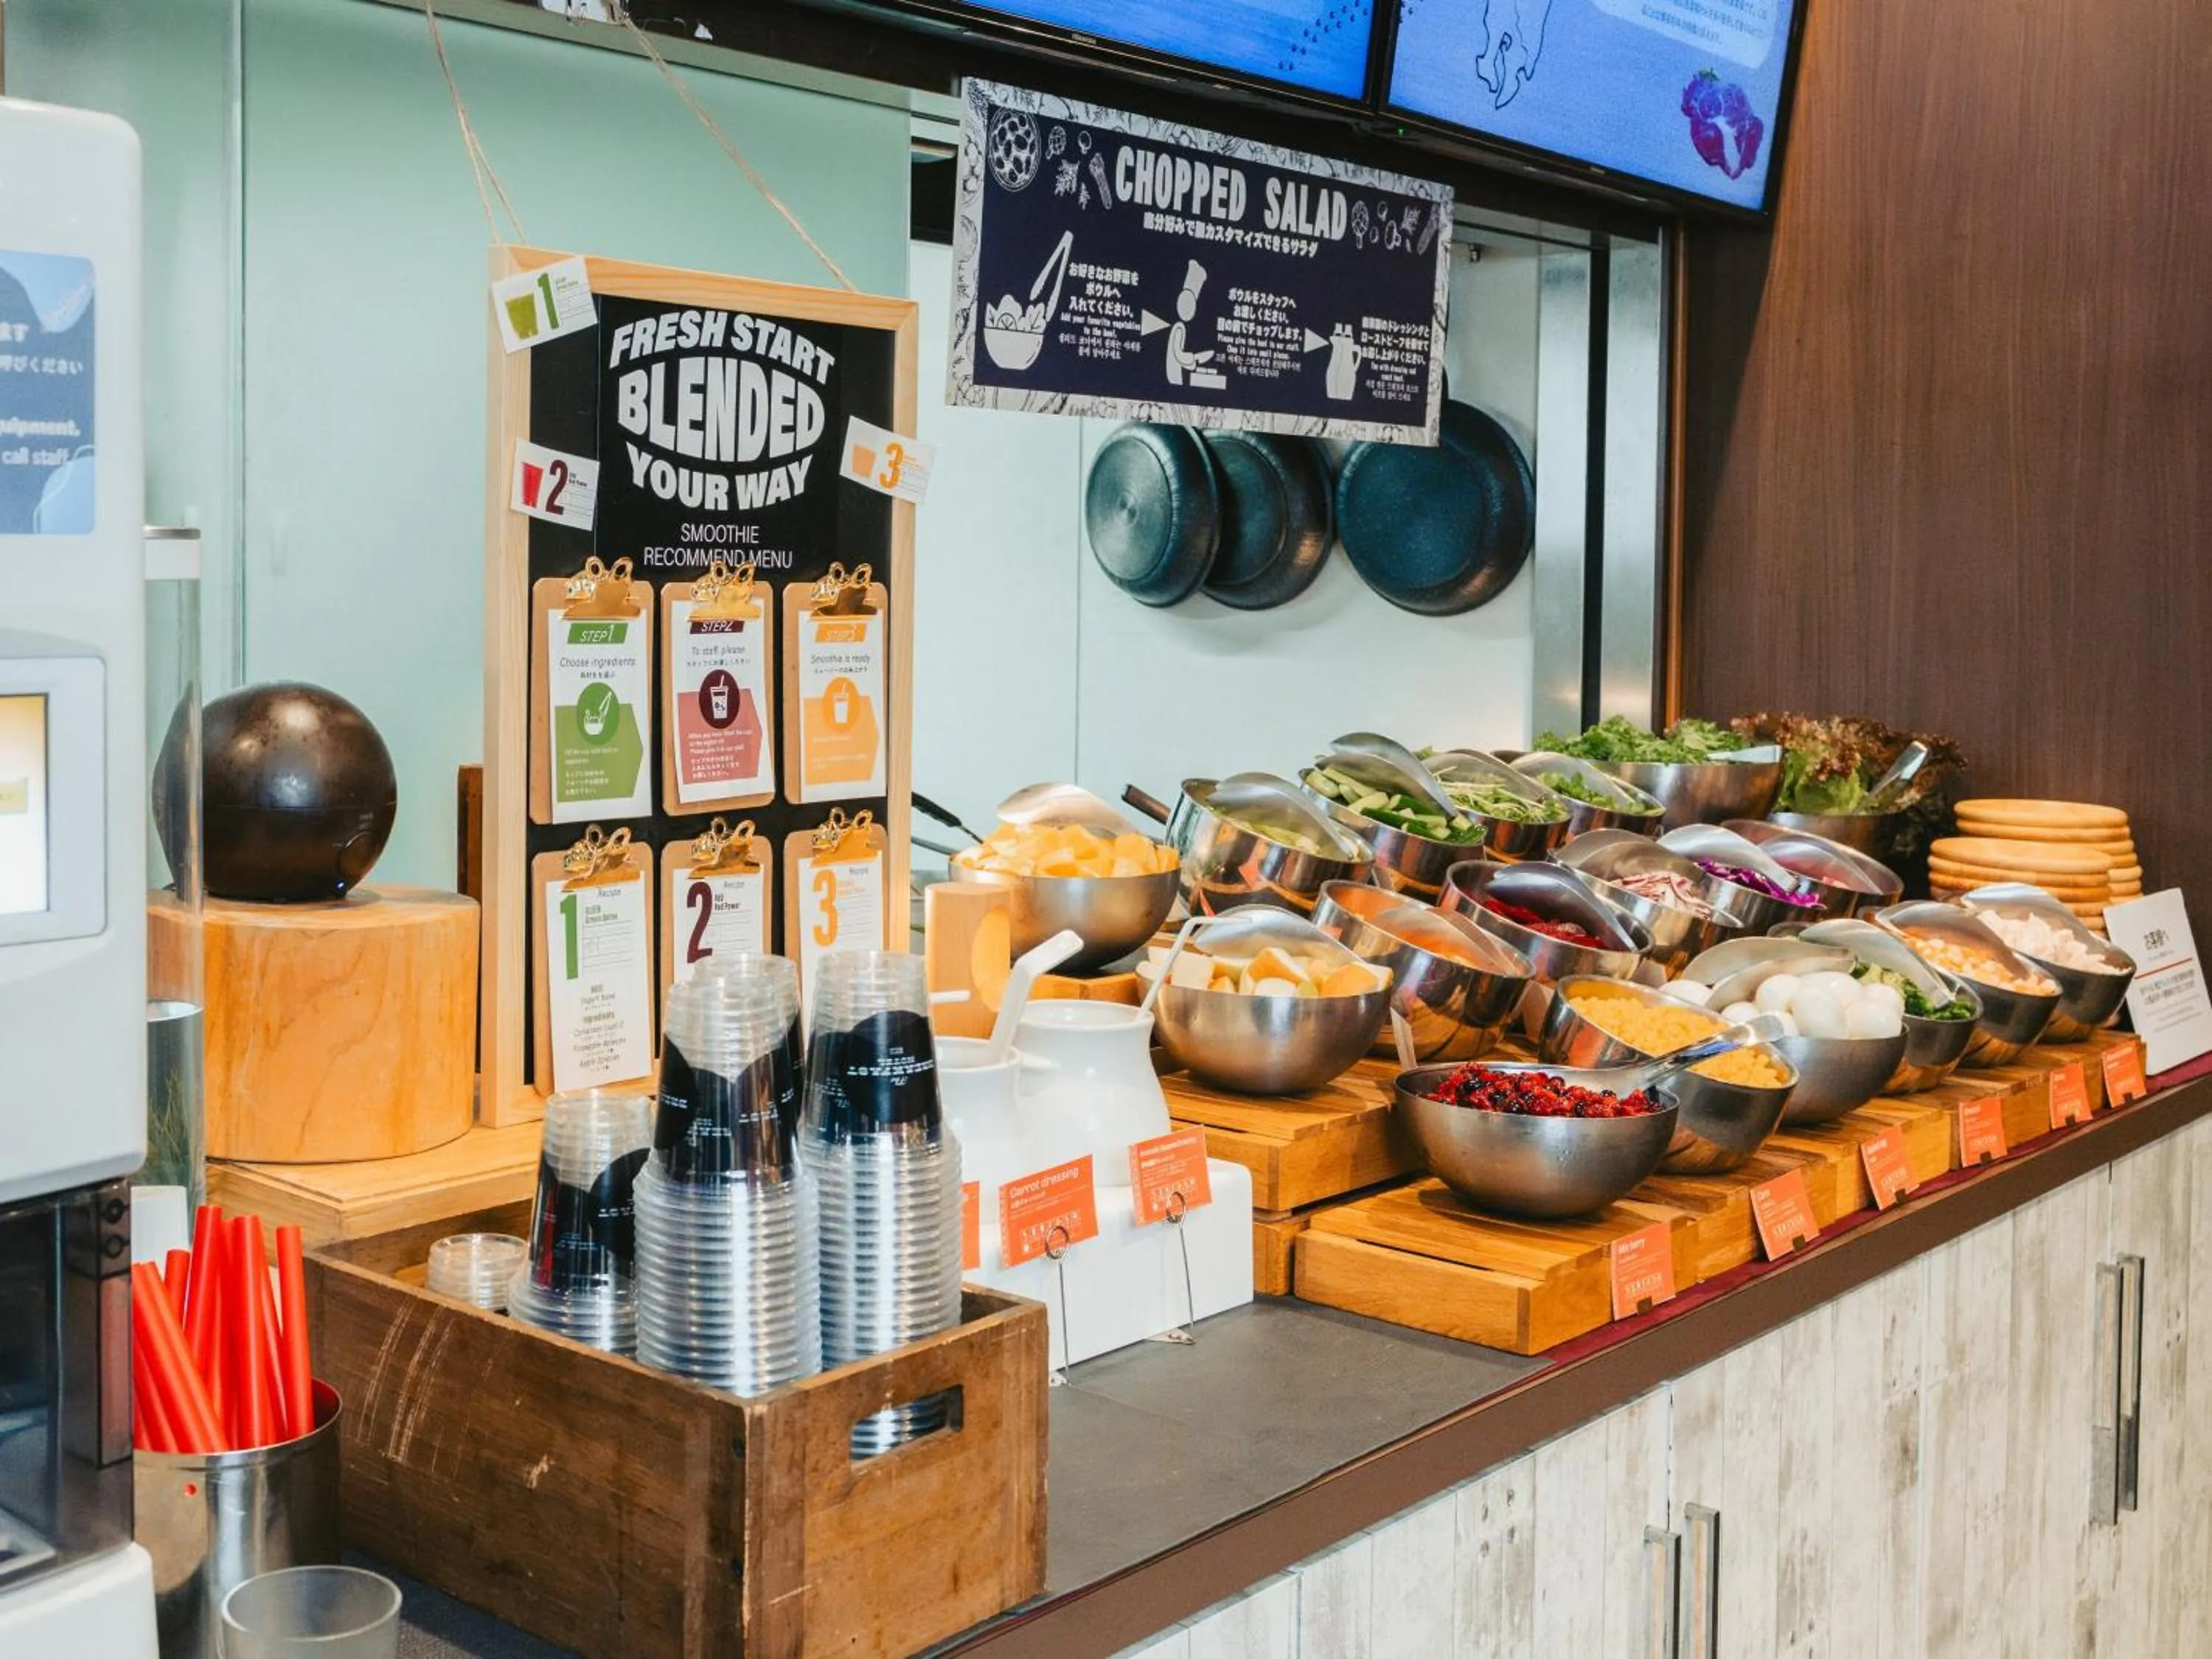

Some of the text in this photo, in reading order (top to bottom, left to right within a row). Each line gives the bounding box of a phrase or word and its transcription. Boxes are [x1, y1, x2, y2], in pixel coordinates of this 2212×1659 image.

[1116, 146, 1347, 240] CHOPPED SALAD
[537, 272, 559, 330] 1
[1085, 281, 1121, 298] ボウルへ
[609, 310, 835, 385] FRESH START
[0, 417, 80, 438] uipment.
[618, 356, 825, 462] BLENDED
[1, 447, 29, 465] call
[626, 442, 813, 510] YOUR WAY
[880, 442, 903, 489] 3
[546, 459, 568, 515] 2
[644, 546, 793, 568] RECOMMEND MENU
[681, 524, 759, 544] SMOOTHIE
[580, 625, 614, 641] STEP1
[560, 655, 636, 669] Choose ingredients
[686, 881, 713, 964] 2
[813, 869, 839, 947] 3
[560, 893, 578, 979] 1
[1009, 1166, 1079, 1199] Carrot dressing
